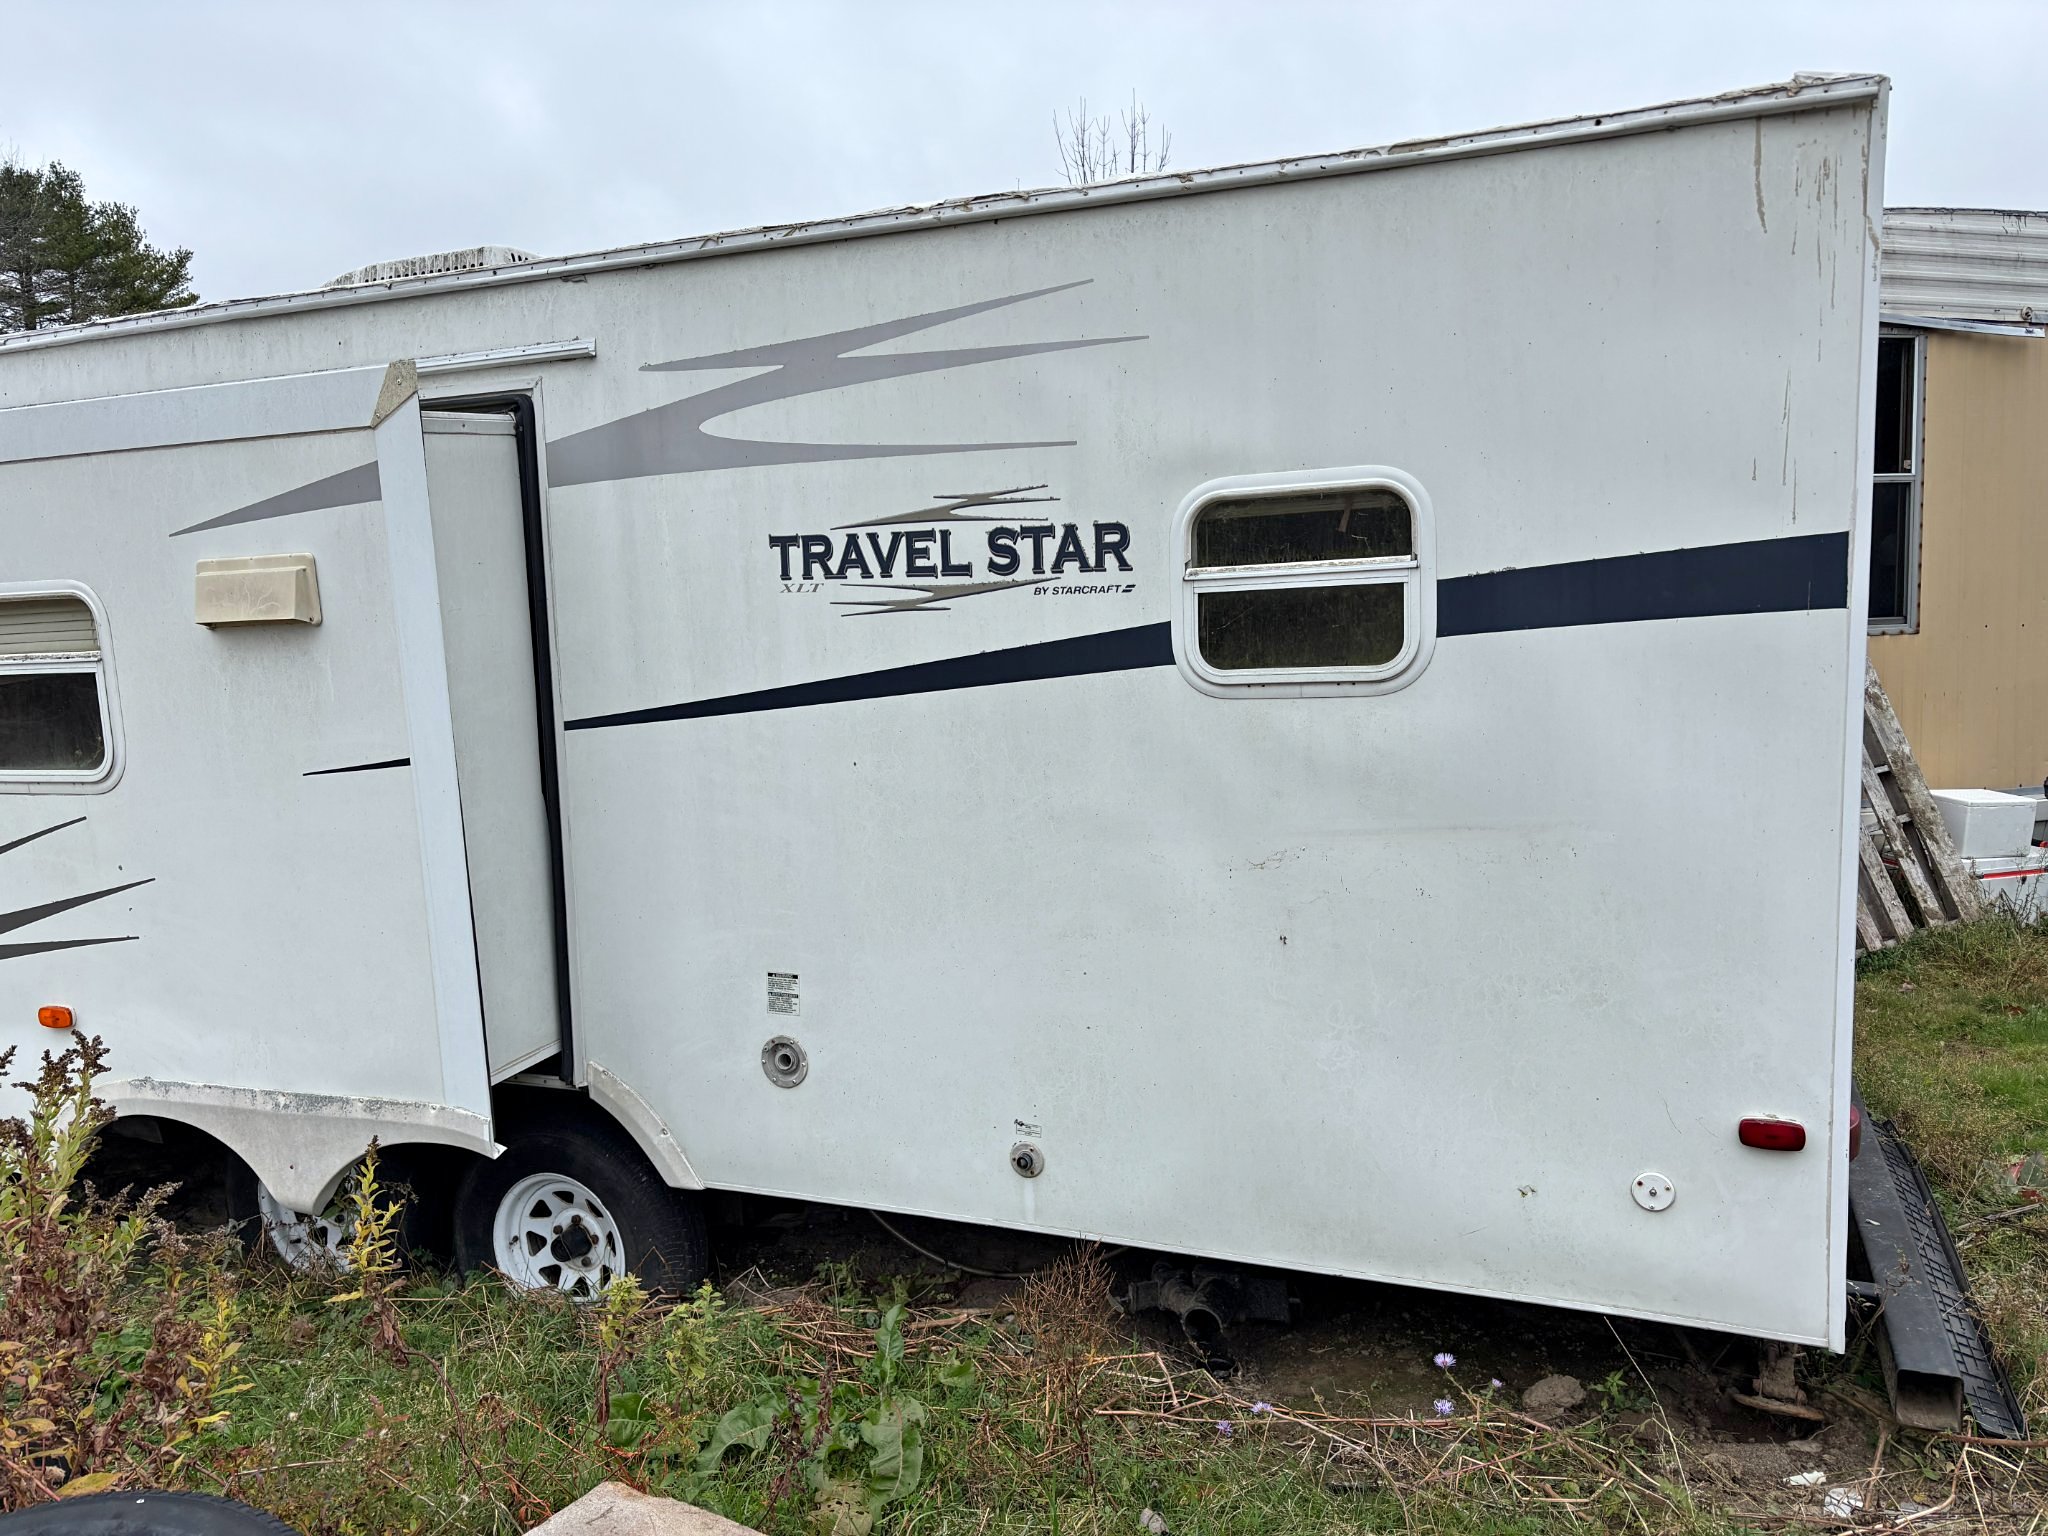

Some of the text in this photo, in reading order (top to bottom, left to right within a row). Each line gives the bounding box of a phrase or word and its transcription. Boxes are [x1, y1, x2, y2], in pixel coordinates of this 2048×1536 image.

[768, 521, 1133, 581] TRAVEL STAR
[779, 582, 825, 594] XLT
[1033, 584, 1122, 596] BY STARCRAFT
